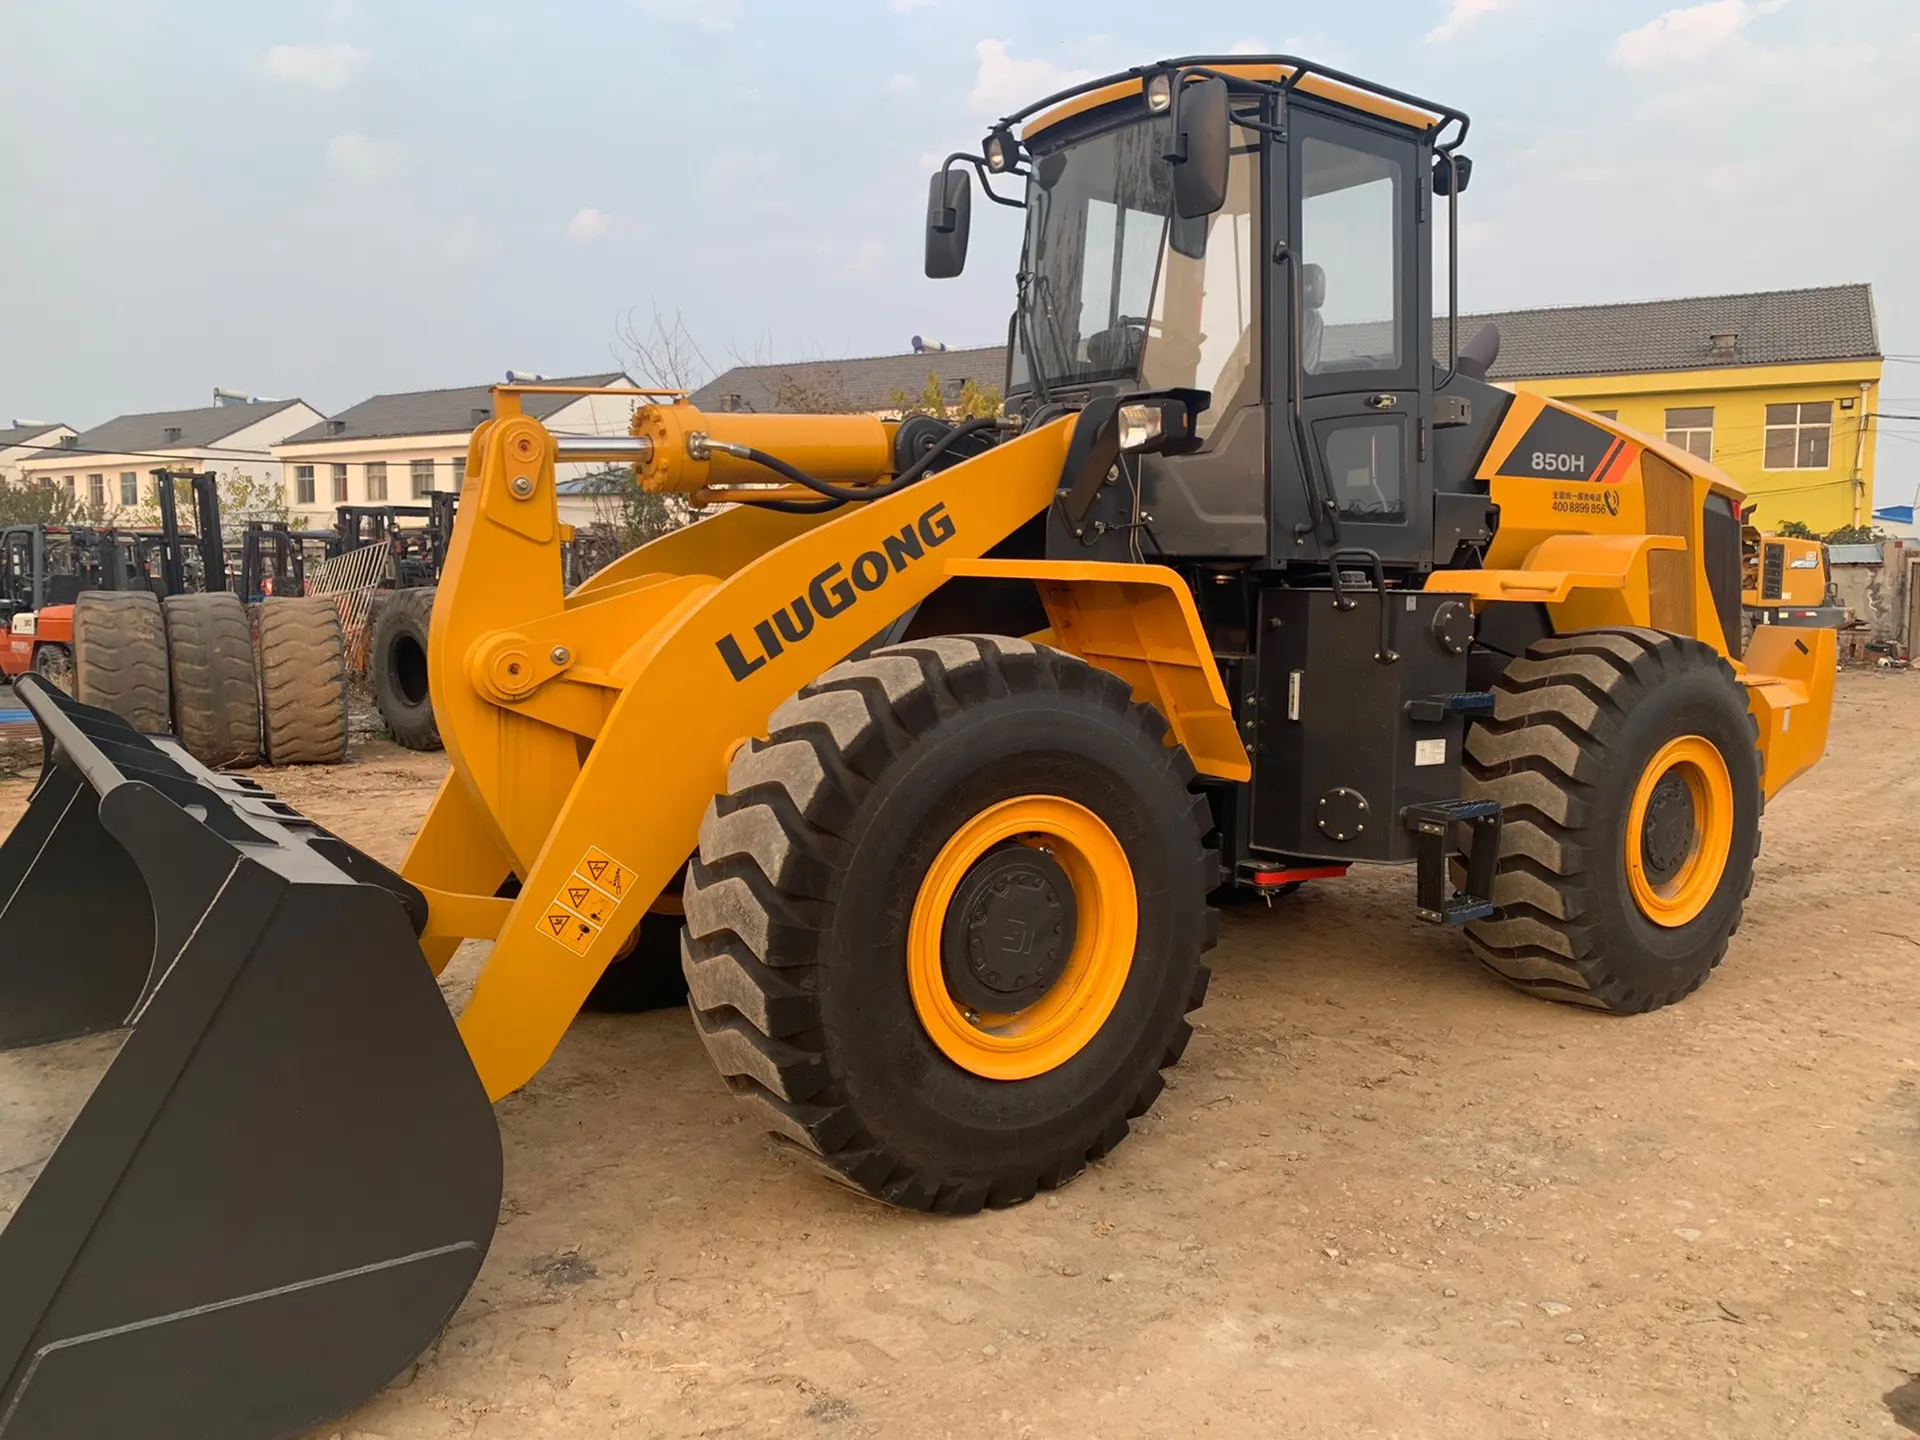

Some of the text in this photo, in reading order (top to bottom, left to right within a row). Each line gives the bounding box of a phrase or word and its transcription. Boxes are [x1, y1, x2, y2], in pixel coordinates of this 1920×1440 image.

[1531, 451, 1585, 473] 850H
[1552, 501, 1606, 514] 400 8899 856
[715, 501, 957, 683] LIUGONG
